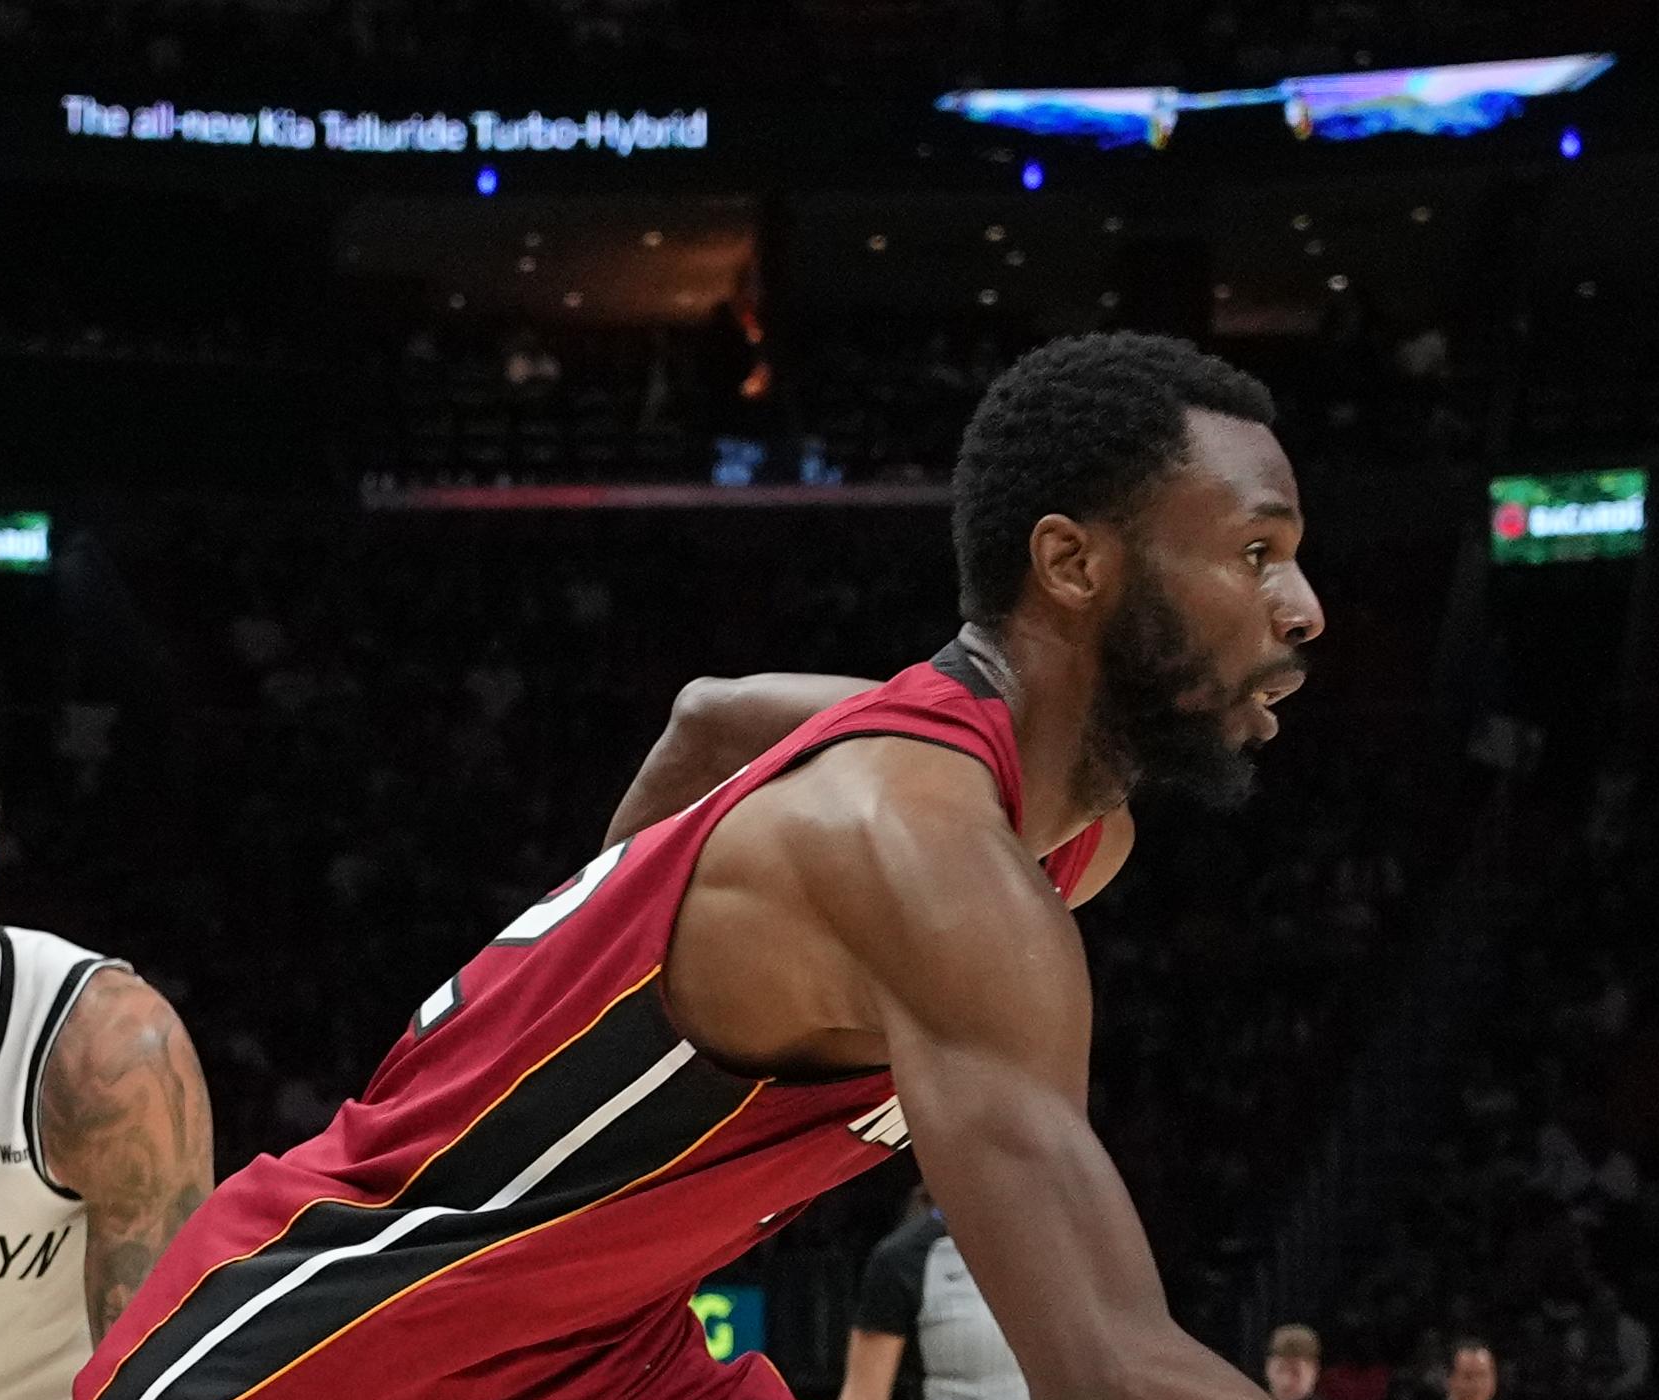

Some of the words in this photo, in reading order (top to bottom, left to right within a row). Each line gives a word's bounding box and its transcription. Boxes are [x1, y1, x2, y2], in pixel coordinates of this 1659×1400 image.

[61, 94, 130, 137] The
[132, 101, 256, 144] all-new
[257, 107, 315, 149] Kia
[319, 109, 468, 152] Telluride
[469, 109, 707, 156] Turbo-Hybrid
